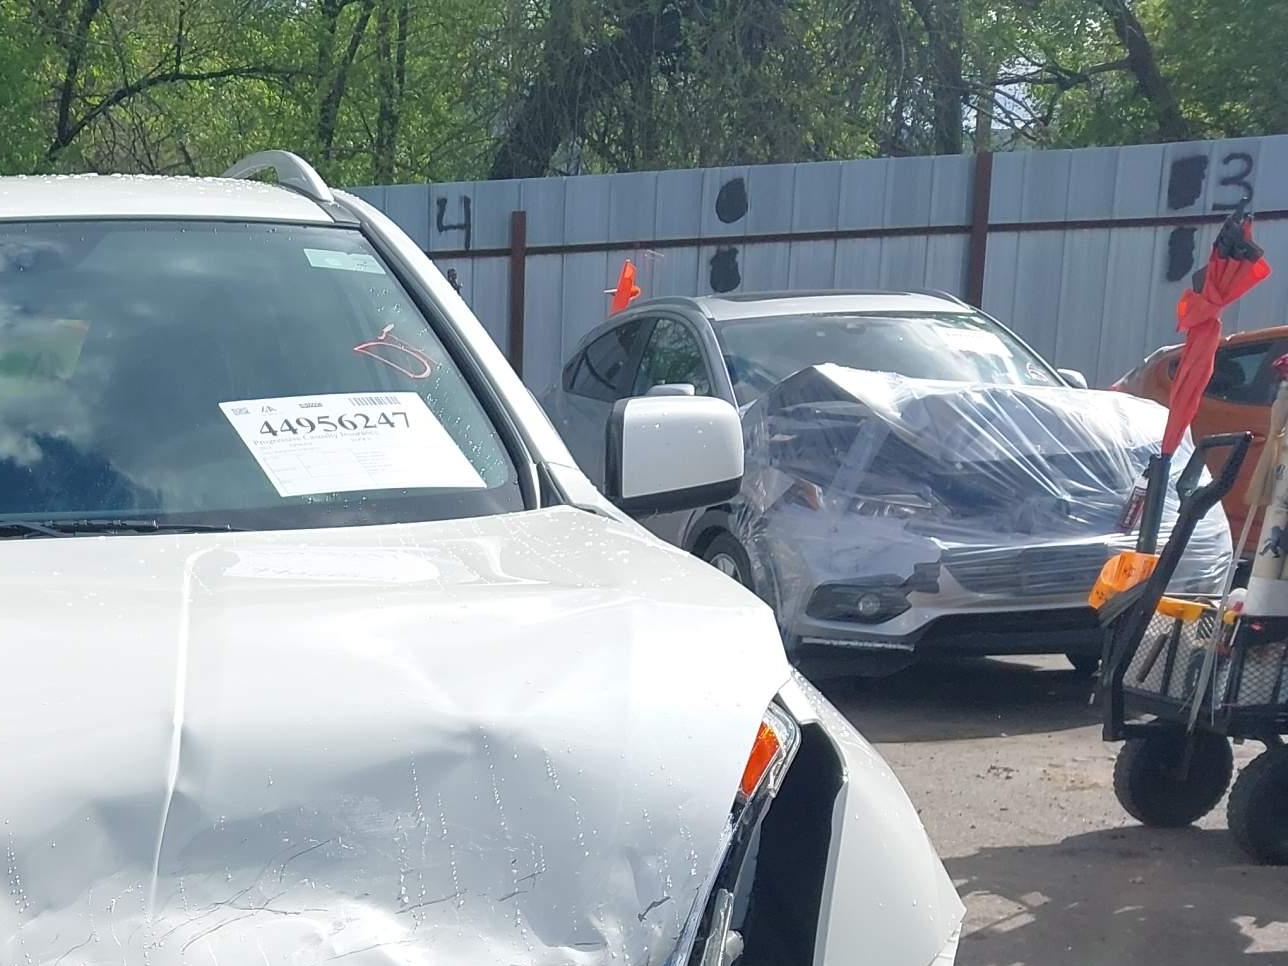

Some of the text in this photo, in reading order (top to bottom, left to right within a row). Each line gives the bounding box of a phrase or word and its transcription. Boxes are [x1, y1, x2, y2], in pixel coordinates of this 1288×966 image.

[1212, 152, 1253, 211] 3
[436, 195, 471, 250] 4
[259, 411, 410, 437] 44956247
